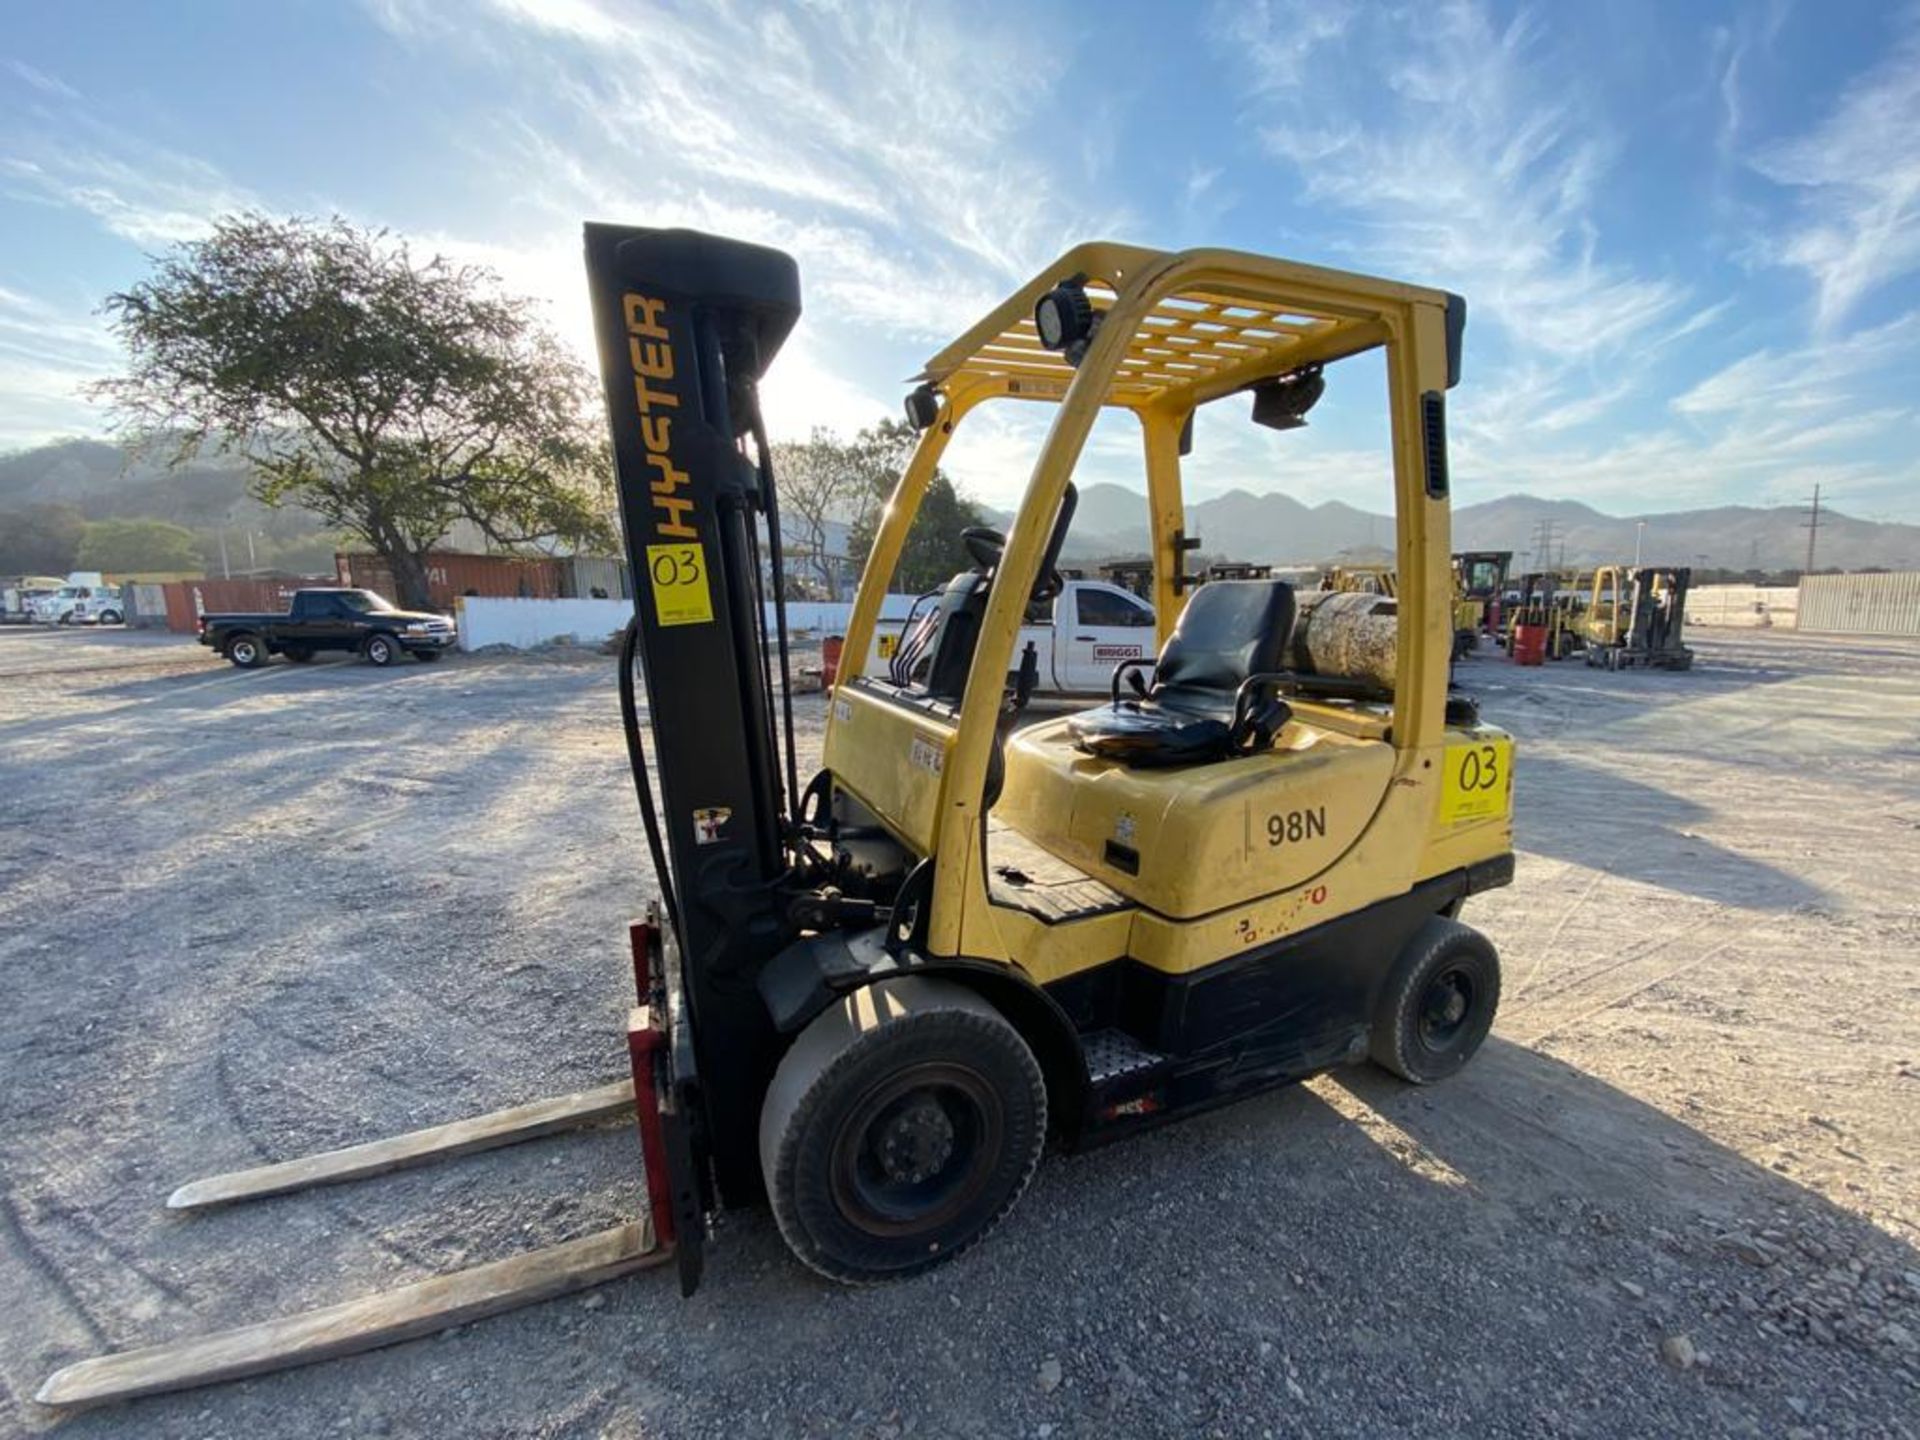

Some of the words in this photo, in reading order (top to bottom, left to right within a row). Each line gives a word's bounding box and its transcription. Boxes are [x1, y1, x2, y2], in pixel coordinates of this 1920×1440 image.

[623, 293, 697, 537] HYSTER
[653, 550, 700, 586] 03
[1096, 648, 1139, 657] BRIGGS
[1459, 745, 1498, 791] 03
[1267, 806, 1326, 846] 98N
